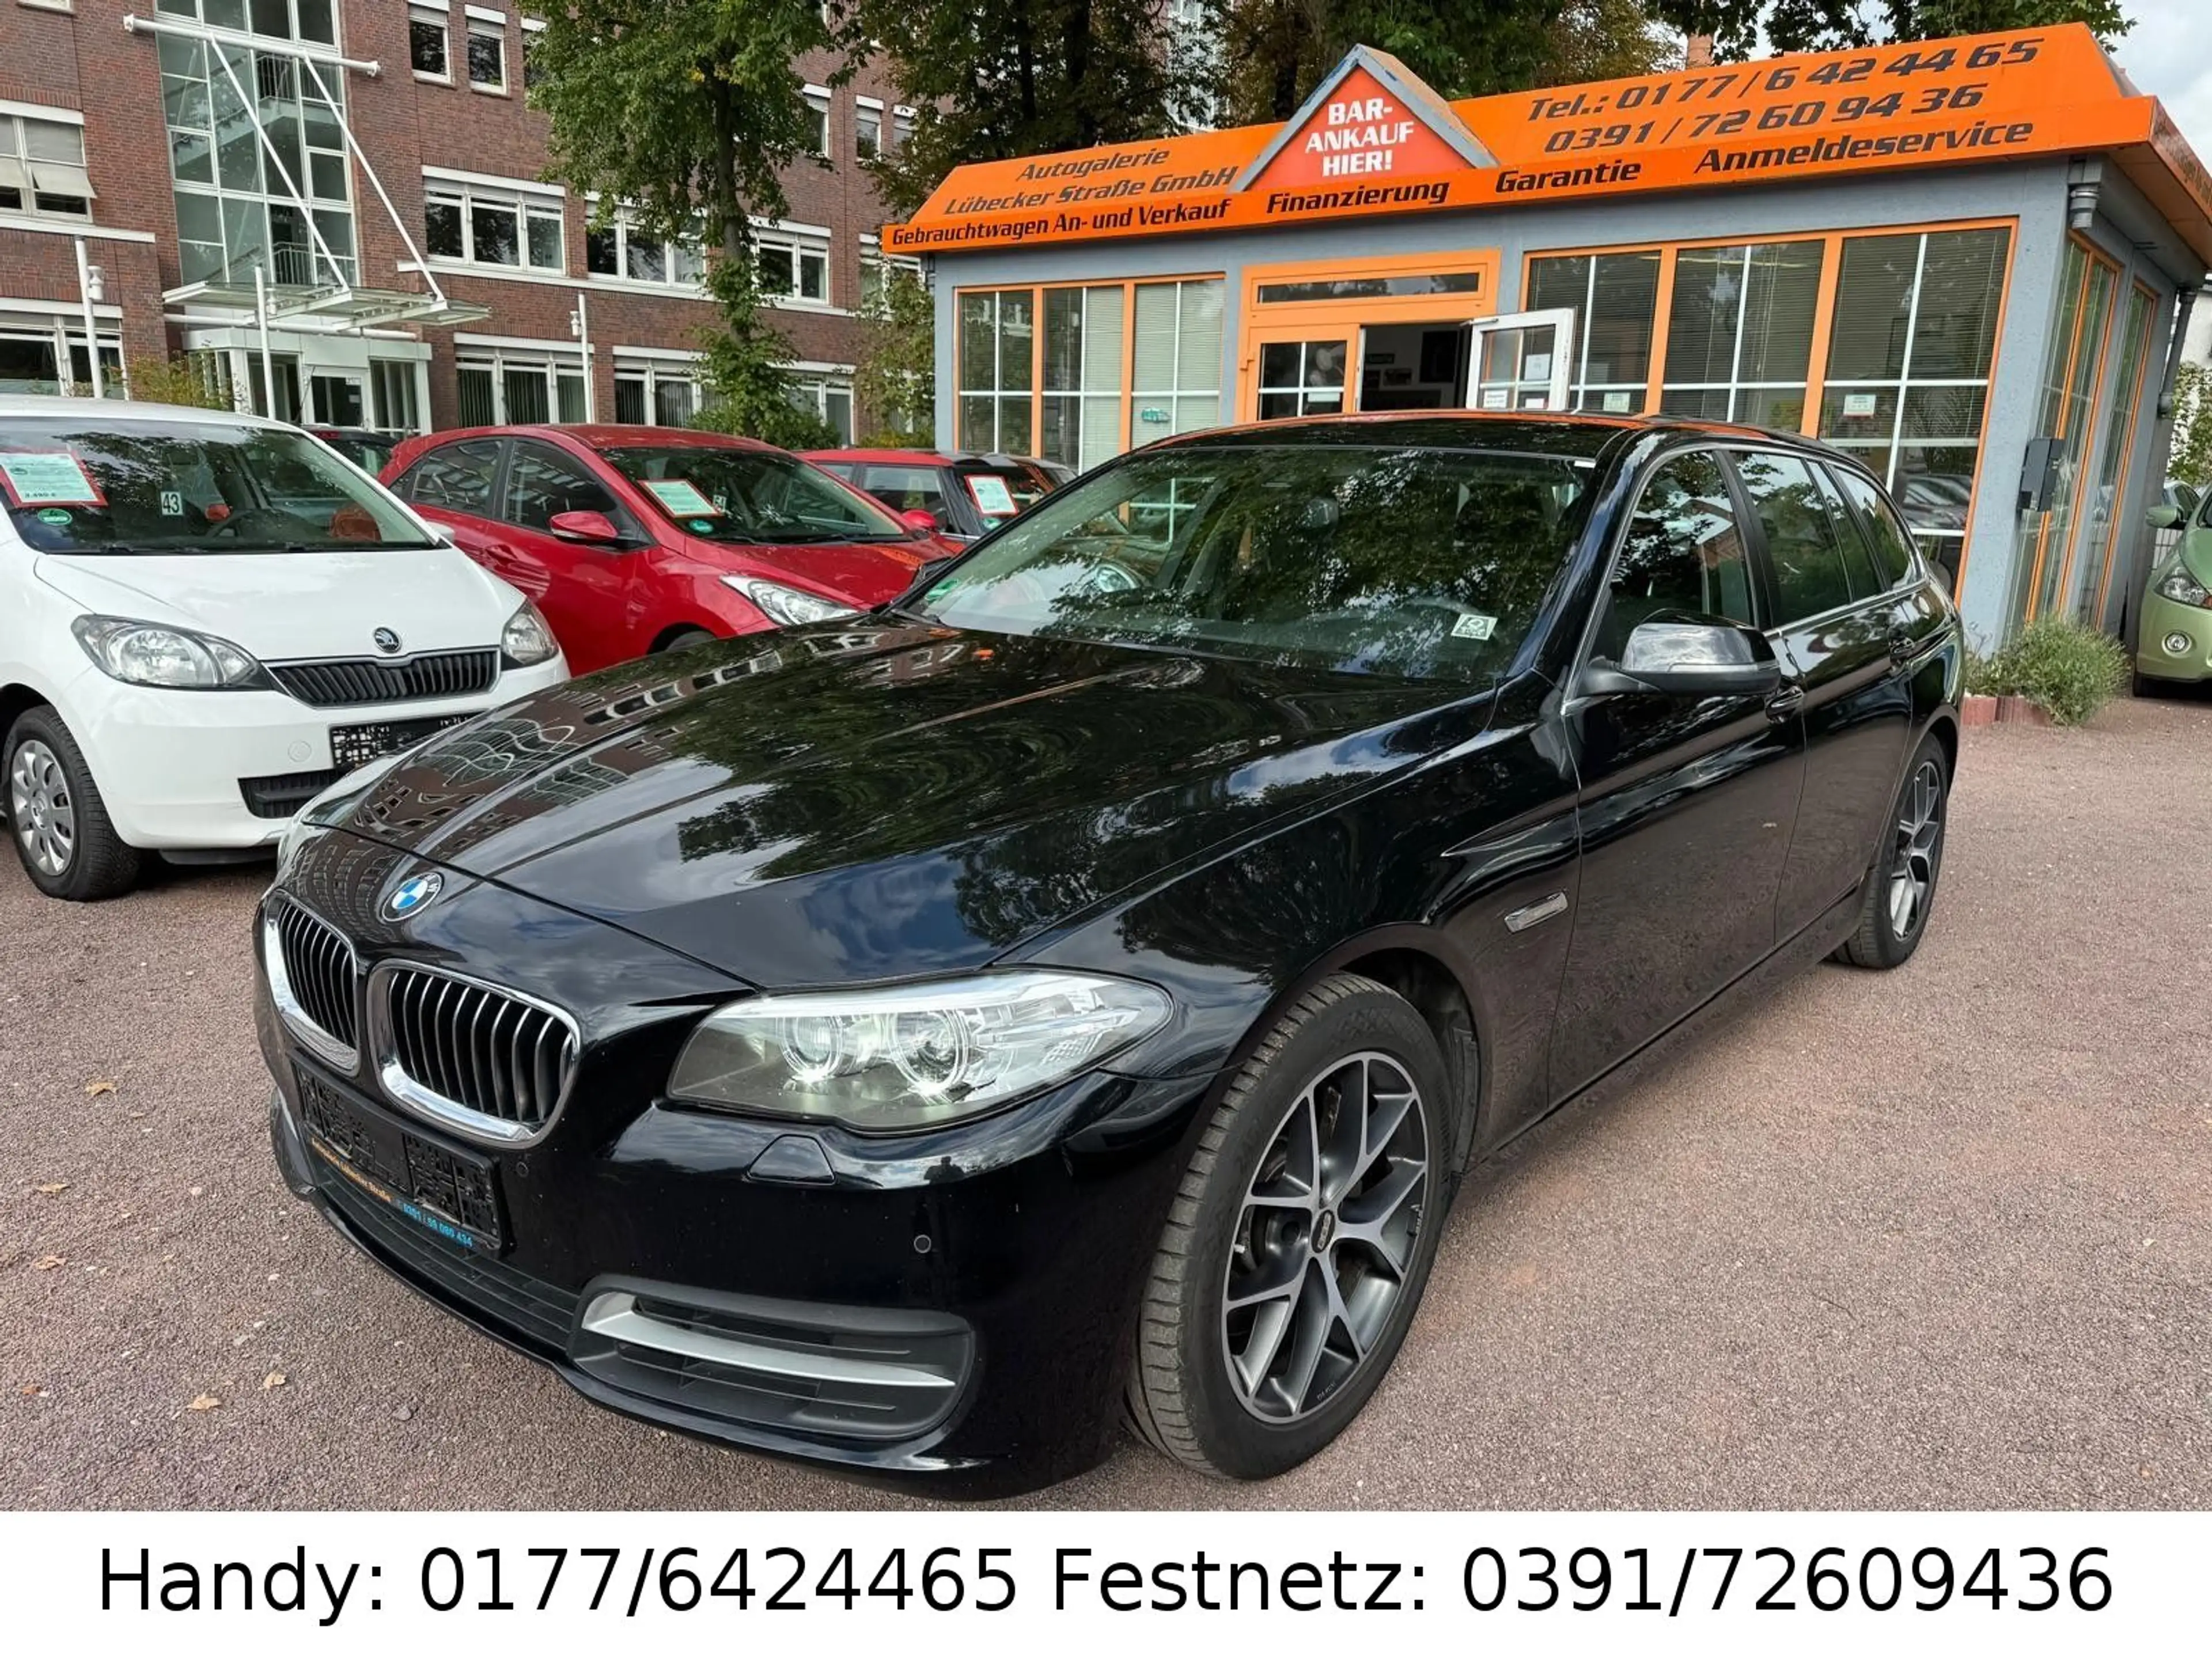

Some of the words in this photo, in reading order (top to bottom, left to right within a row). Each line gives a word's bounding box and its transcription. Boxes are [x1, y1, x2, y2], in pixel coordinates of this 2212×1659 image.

[1528, 94, 1610, 121] Tel.:
[1616, 74, 1738, 108] 0177
[1807, 58, 1877, 85] 42
[1884, 48, 1957, 76] 44
[1965, 38, 2044, 68] 65
[1328, 98, 1393, 126] BAR-
[1544, 121, 1656, 153] 0391
[1690, 109, 1751, 138] 72
[1757, 101, 1825, 130] 60
[1832, 92, 1906, 122] 94
[1912, 83, 1988, 113] 36
[1305, 122, 1414, 154] ANKAUF
[1694, 121, 2033, 173] Anmeldeservice
[1015, 147, 1170, 182] Autogalerie
[1322, 151, 1392, 176] HIER!
[1495, 160, 1641, 192] Garantie
[944, 188, 1054, 215] Lübecker
[1058, 179, 1145, 203] Straße
[1150, 166, 1238, 193] GmbH
[1267, 182, 1449, 214] Finanzierung
[892, 218, 1048, 245] Gebrauchtwagen
[1053, 212, 1088, 232] An-
[1092, 203, 1132, 229] und
[1138, 199, 1231, 225] Verkauf
[163, 492, 179, 513] 43
